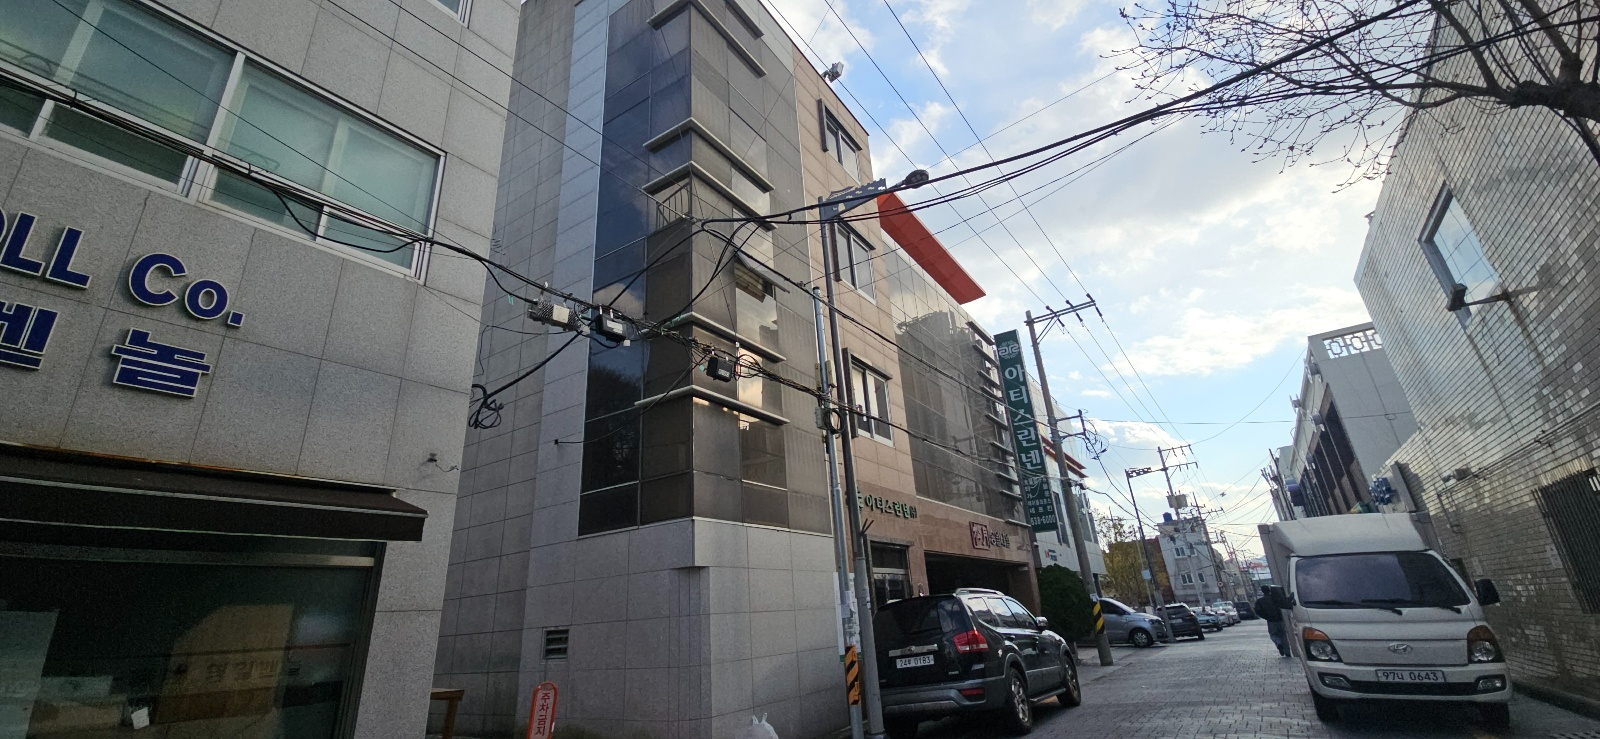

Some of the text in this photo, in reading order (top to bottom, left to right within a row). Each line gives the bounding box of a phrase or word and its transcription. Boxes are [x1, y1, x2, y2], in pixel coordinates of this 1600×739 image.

[0, 206, 245, 327] LL Co.
[1004, 364, 1043, 470] 아티스린넨
[1409, 671, 1438, 681] 0643
[535, 692, 551, 736] 주차금지
